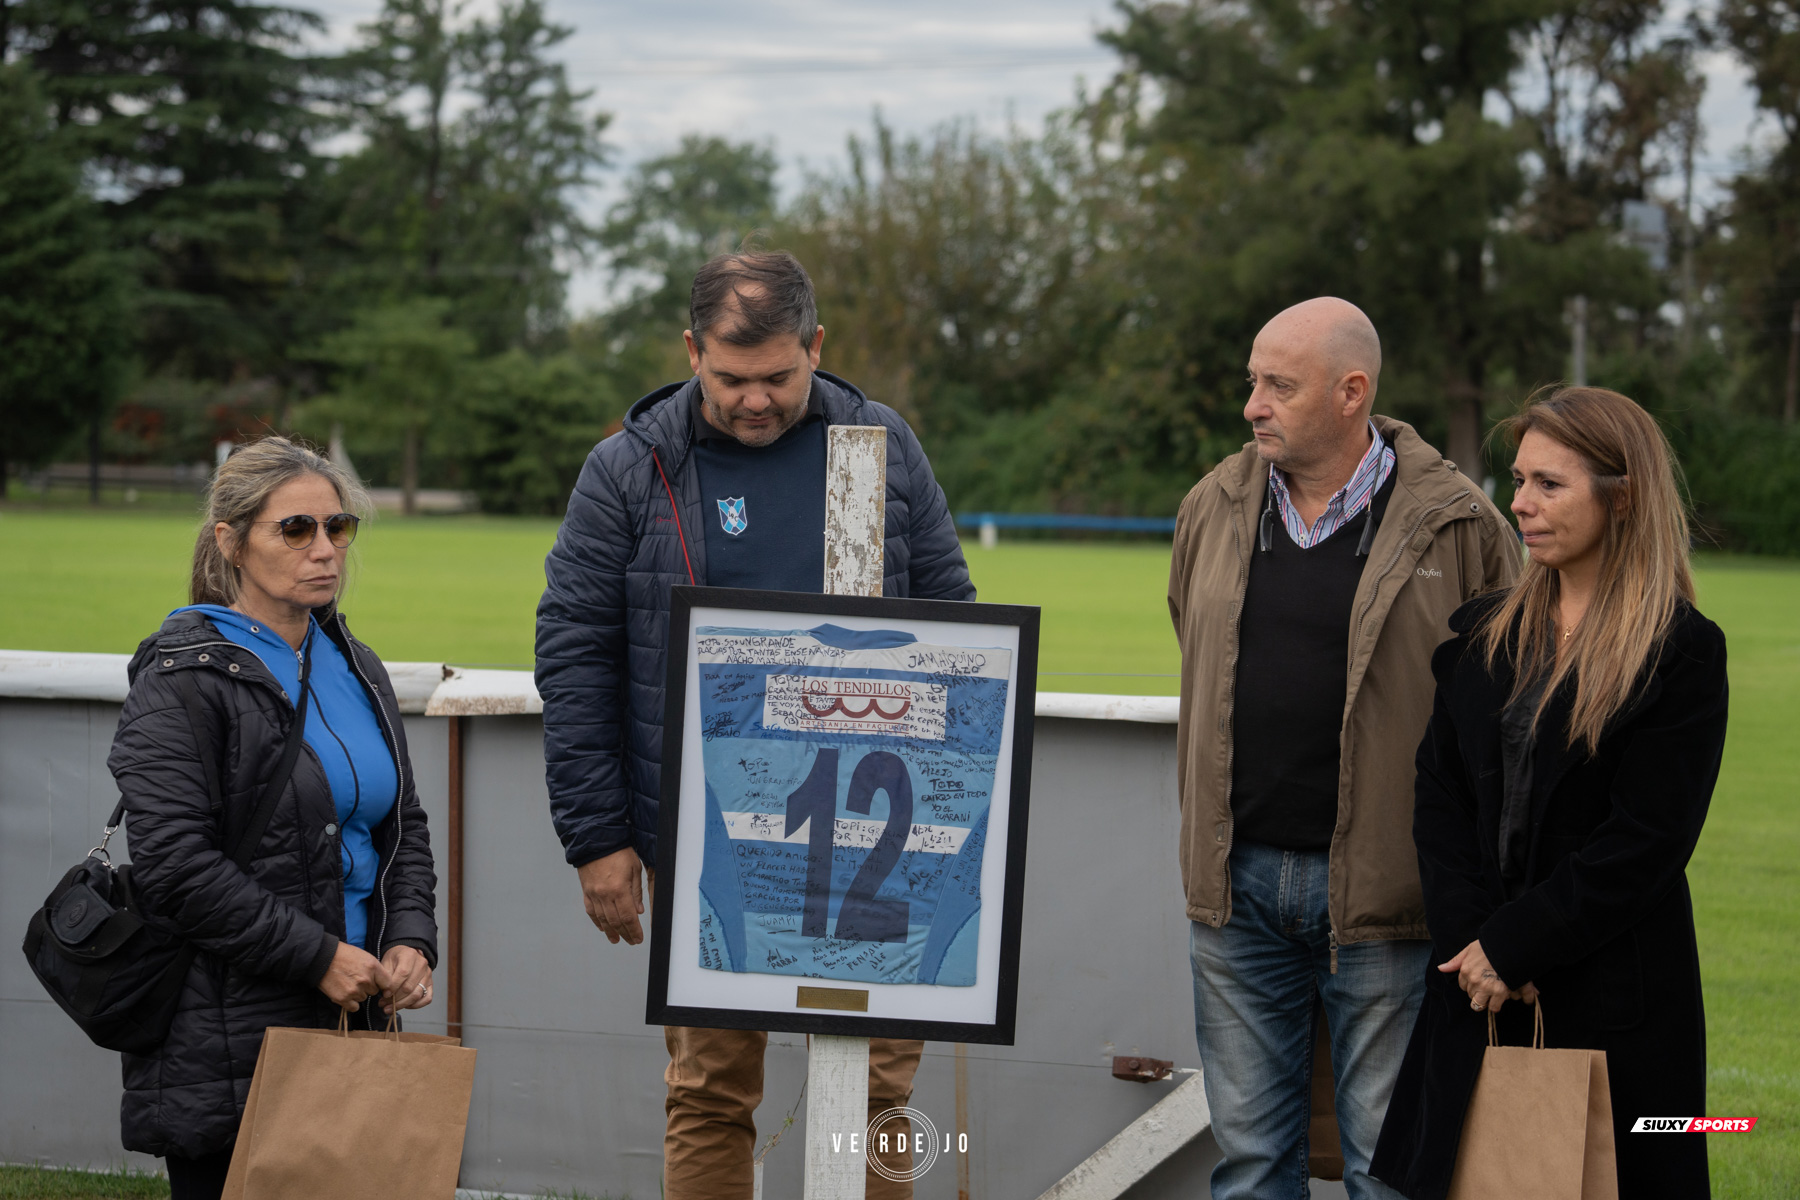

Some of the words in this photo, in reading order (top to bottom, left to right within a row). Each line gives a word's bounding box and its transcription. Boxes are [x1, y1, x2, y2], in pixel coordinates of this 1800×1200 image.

[752, 636, 796, 648] GRANDE
[802, 680, 828, 692] LOS
[834, 681, 912, 696] TENDILLOS
[866, 724, 910, 732] FACTURAS
[736, 844, 782, 858] QUERIDO
[784, 748, 914, 944] 12
